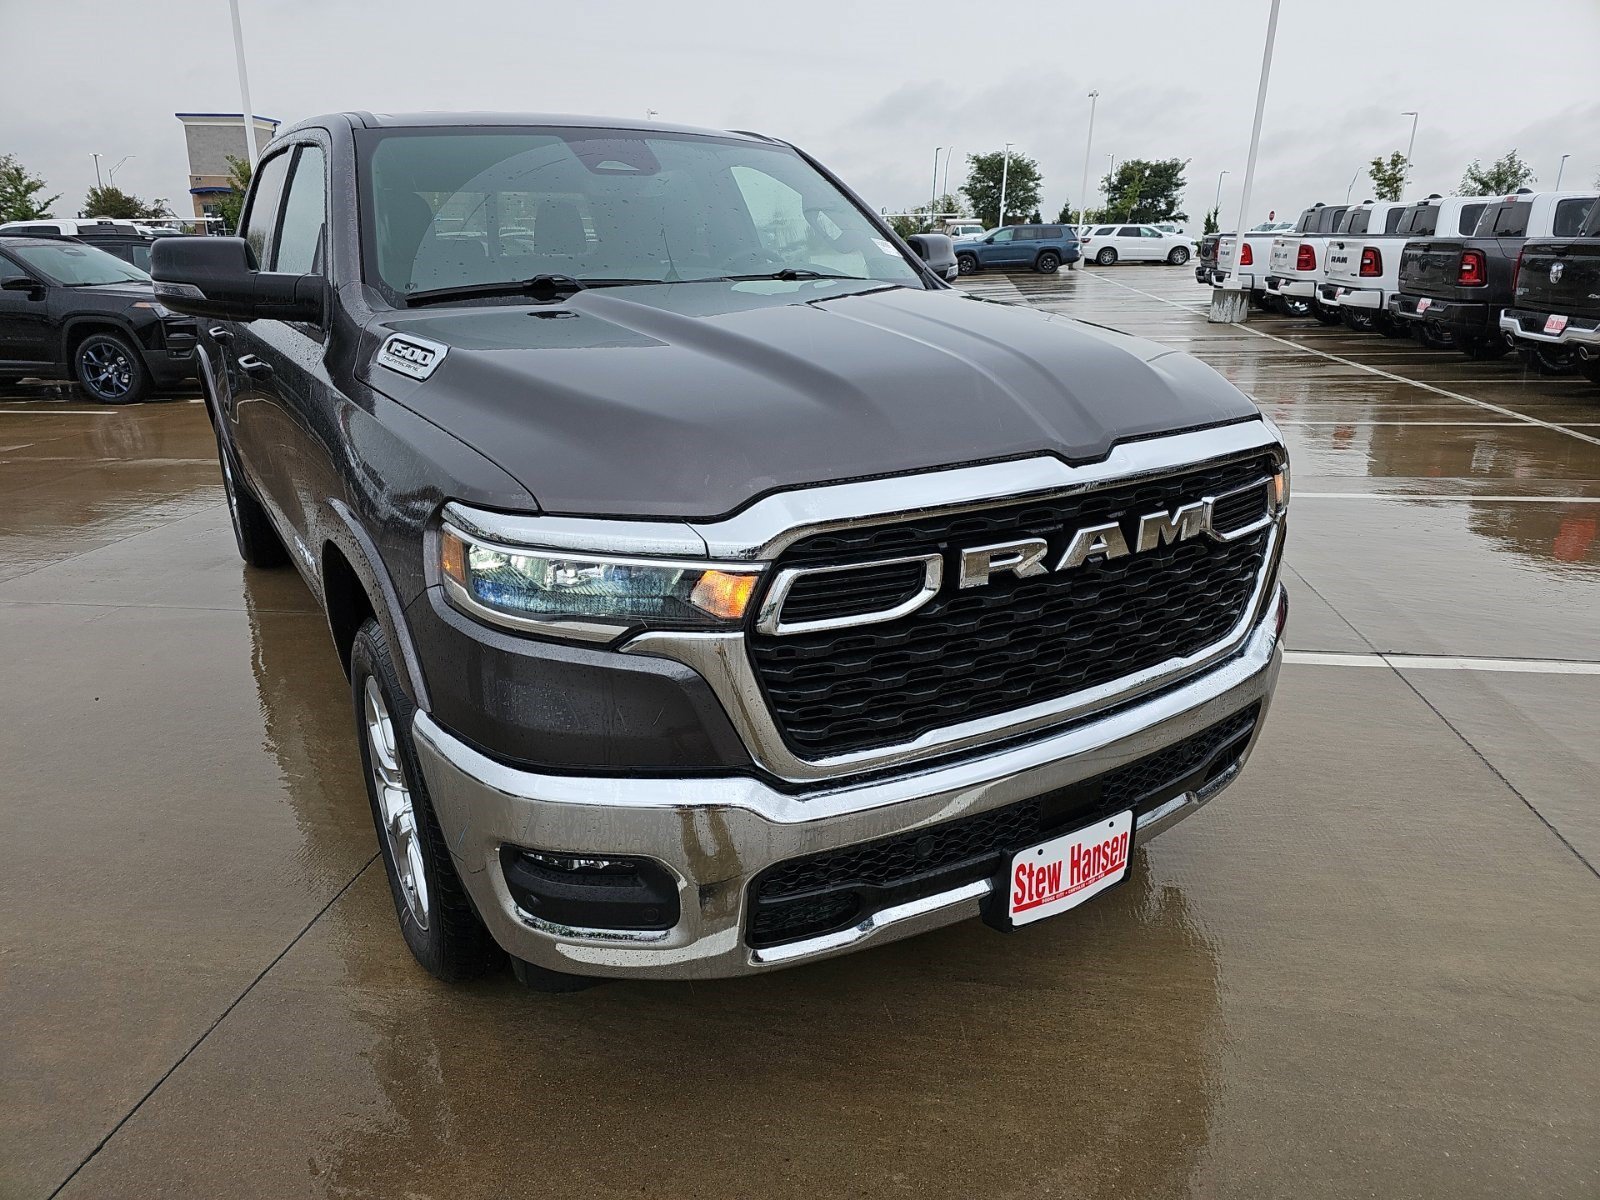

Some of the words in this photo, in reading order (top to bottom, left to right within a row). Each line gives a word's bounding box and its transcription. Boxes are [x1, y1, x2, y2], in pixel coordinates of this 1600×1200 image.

[1331, 256, 1348, 264] RAM
[389, 341, 434, 365] 1500
[959, 501, 1204, 590] RAM
[1013, 860, 1062, 905] Stew
[1070, 831, 1128, 886] Hansen
